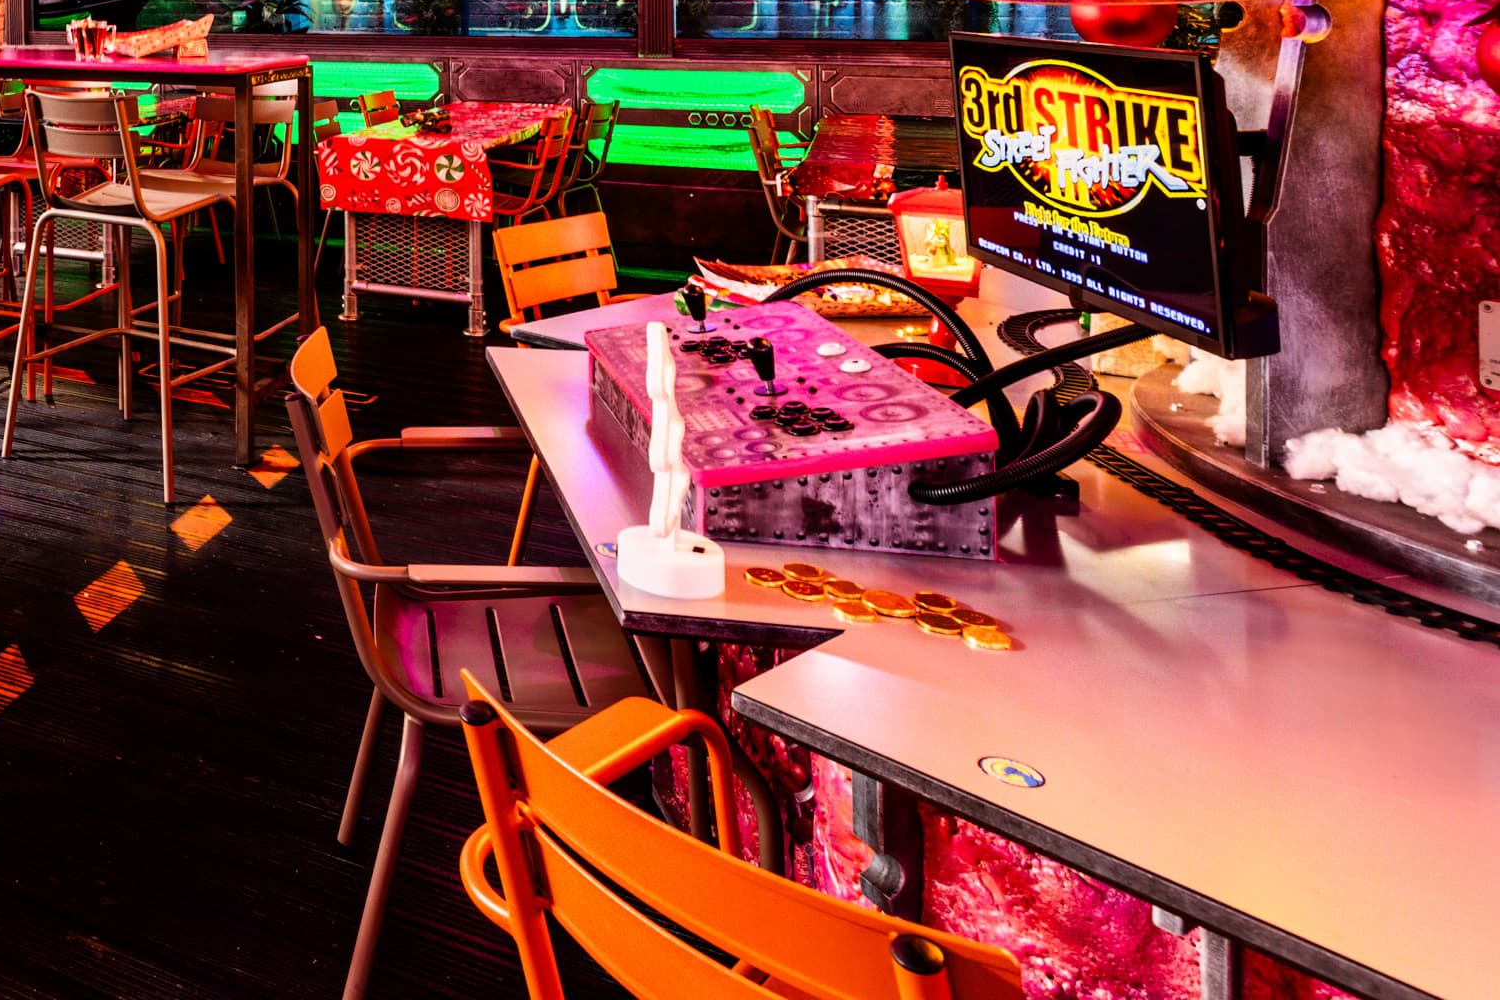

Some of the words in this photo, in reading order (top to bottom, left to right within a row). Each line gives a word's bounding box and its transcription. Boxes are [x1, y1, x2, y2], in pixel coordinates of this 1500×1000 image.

[964, 77, 1024, 134] 3rd
[1033, 86, 1195, 173] STRIKE
[980, 125, 1057, 167] STREET
[1055, 144, 1189, 190] FIGHTER
[1013, 211, 1039, 227] PRESS
[1077, 231, 1105, 250] START
[1110, 242, 1149, 264] BUTTON
[1052, 240, 1086, 260] CREDIT
[1036, 260, 1056, 275] LTD.
[1061, 268, 1083, 285] 1999
[1086, 278, 1104, 294] ALL
[1108, 285, 1146, 309] RIGHTS
[1150, 301, 1212, 334] RESERVED.
